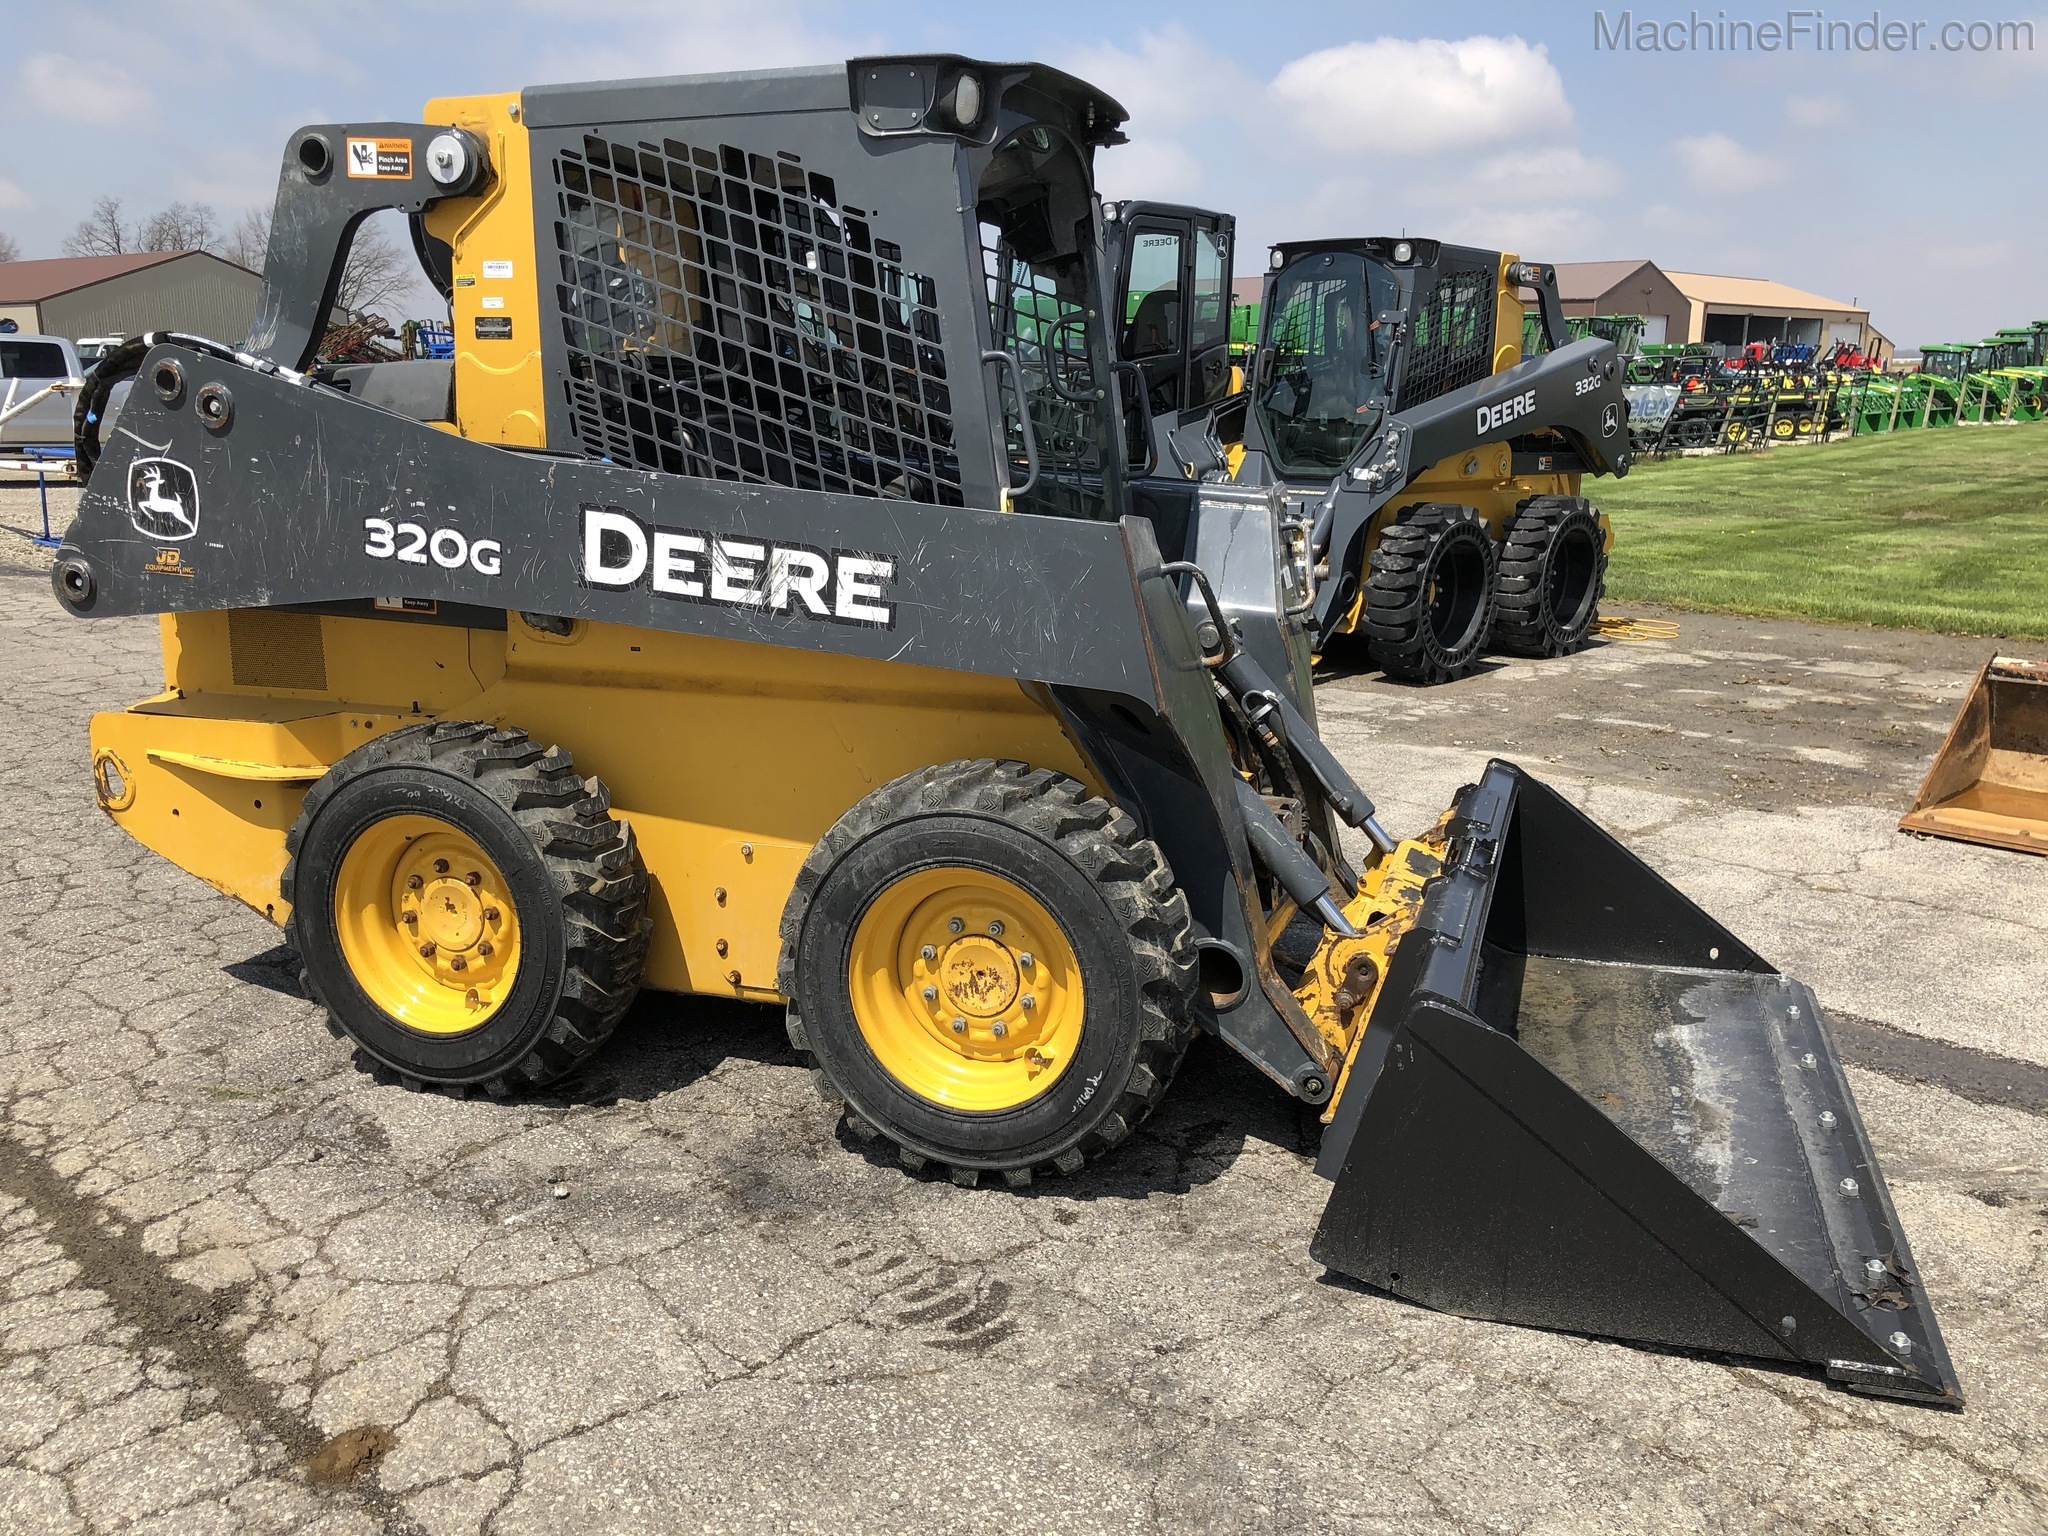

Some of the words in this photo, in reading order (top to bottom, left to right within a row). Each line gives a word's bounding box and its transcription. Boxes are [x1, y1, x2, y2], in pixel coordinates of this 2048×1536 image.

[384, 142, 409, 150] WARNING
[395, 156, 408, 164] Area
[391, 165, 404, 173] Away
[1575, 374, 1601, 397] 332G
[1476, 389, 1536, 436] DEERE
[365, 517, 501, 575] 320G
[156, 550, 180, 565] JD
[144, 563, 181, 573] EQUIPMENT
[584, 509, 894, 624] DEERE
